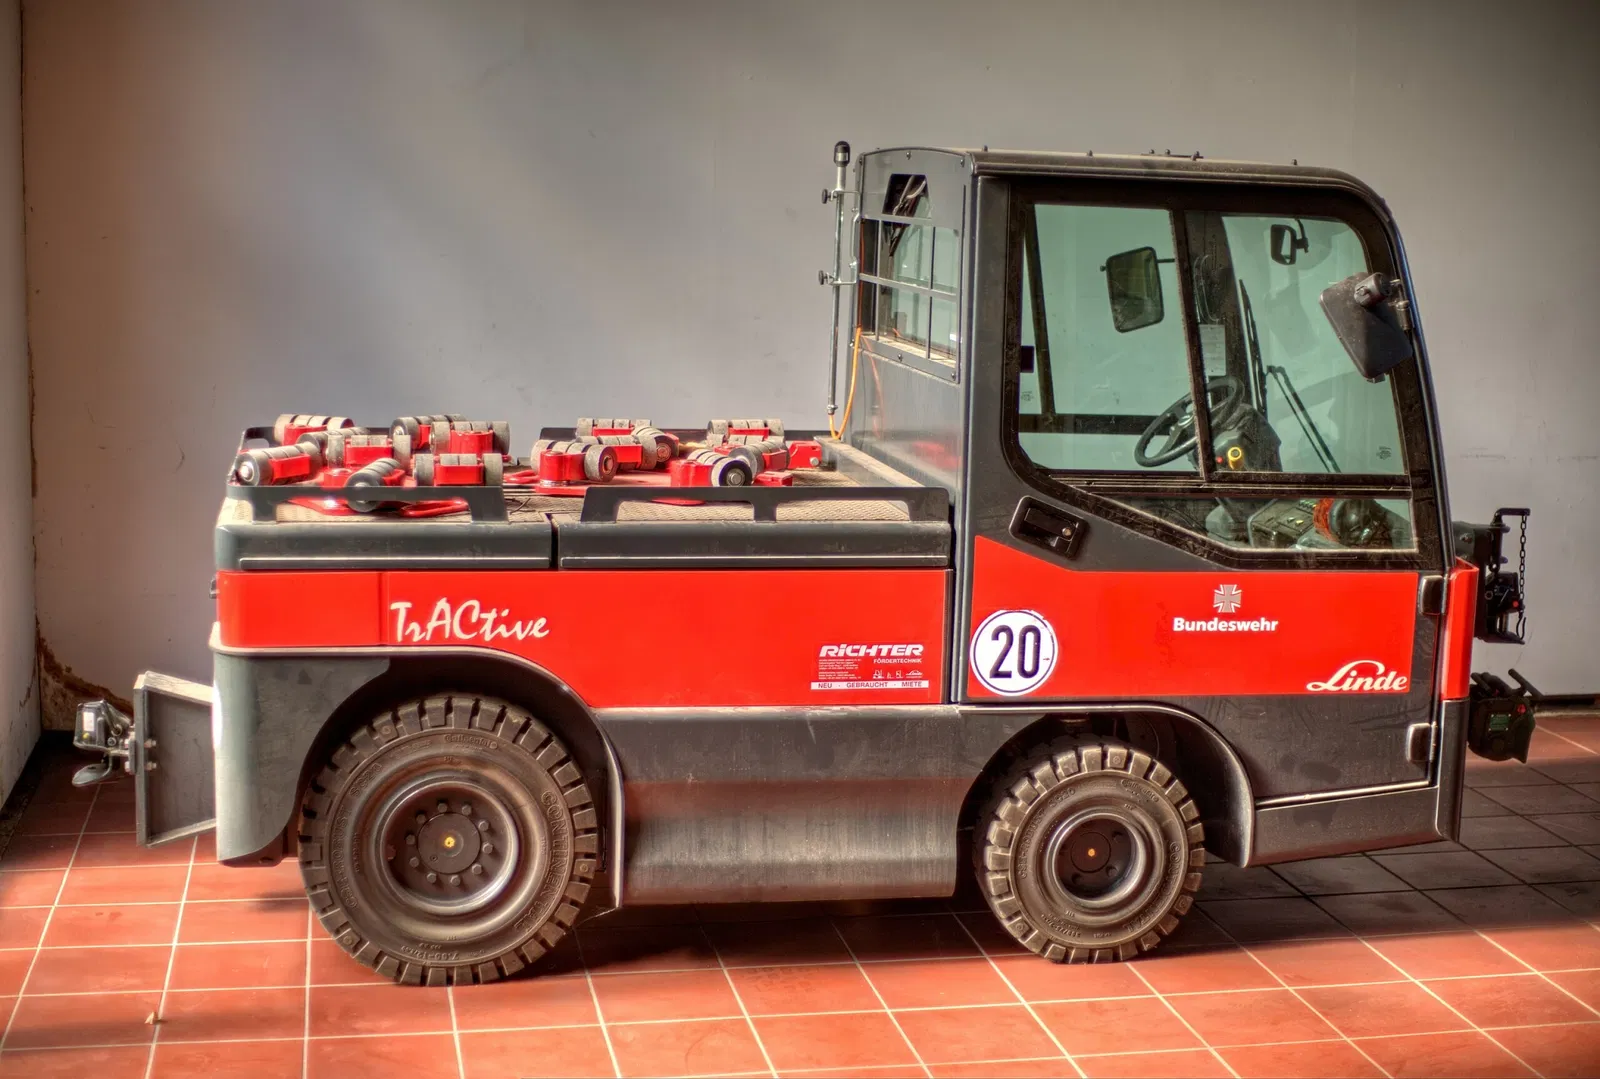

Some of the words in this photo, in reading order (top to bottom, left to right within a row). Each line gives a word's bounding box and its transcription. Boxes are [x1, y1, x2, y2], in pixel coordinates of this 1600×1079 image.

[1173, 616, 1278, 632] Bundeswehr
[989, 624, 1042, 679] 20
[1306, 659, 1408, 692] Linde
